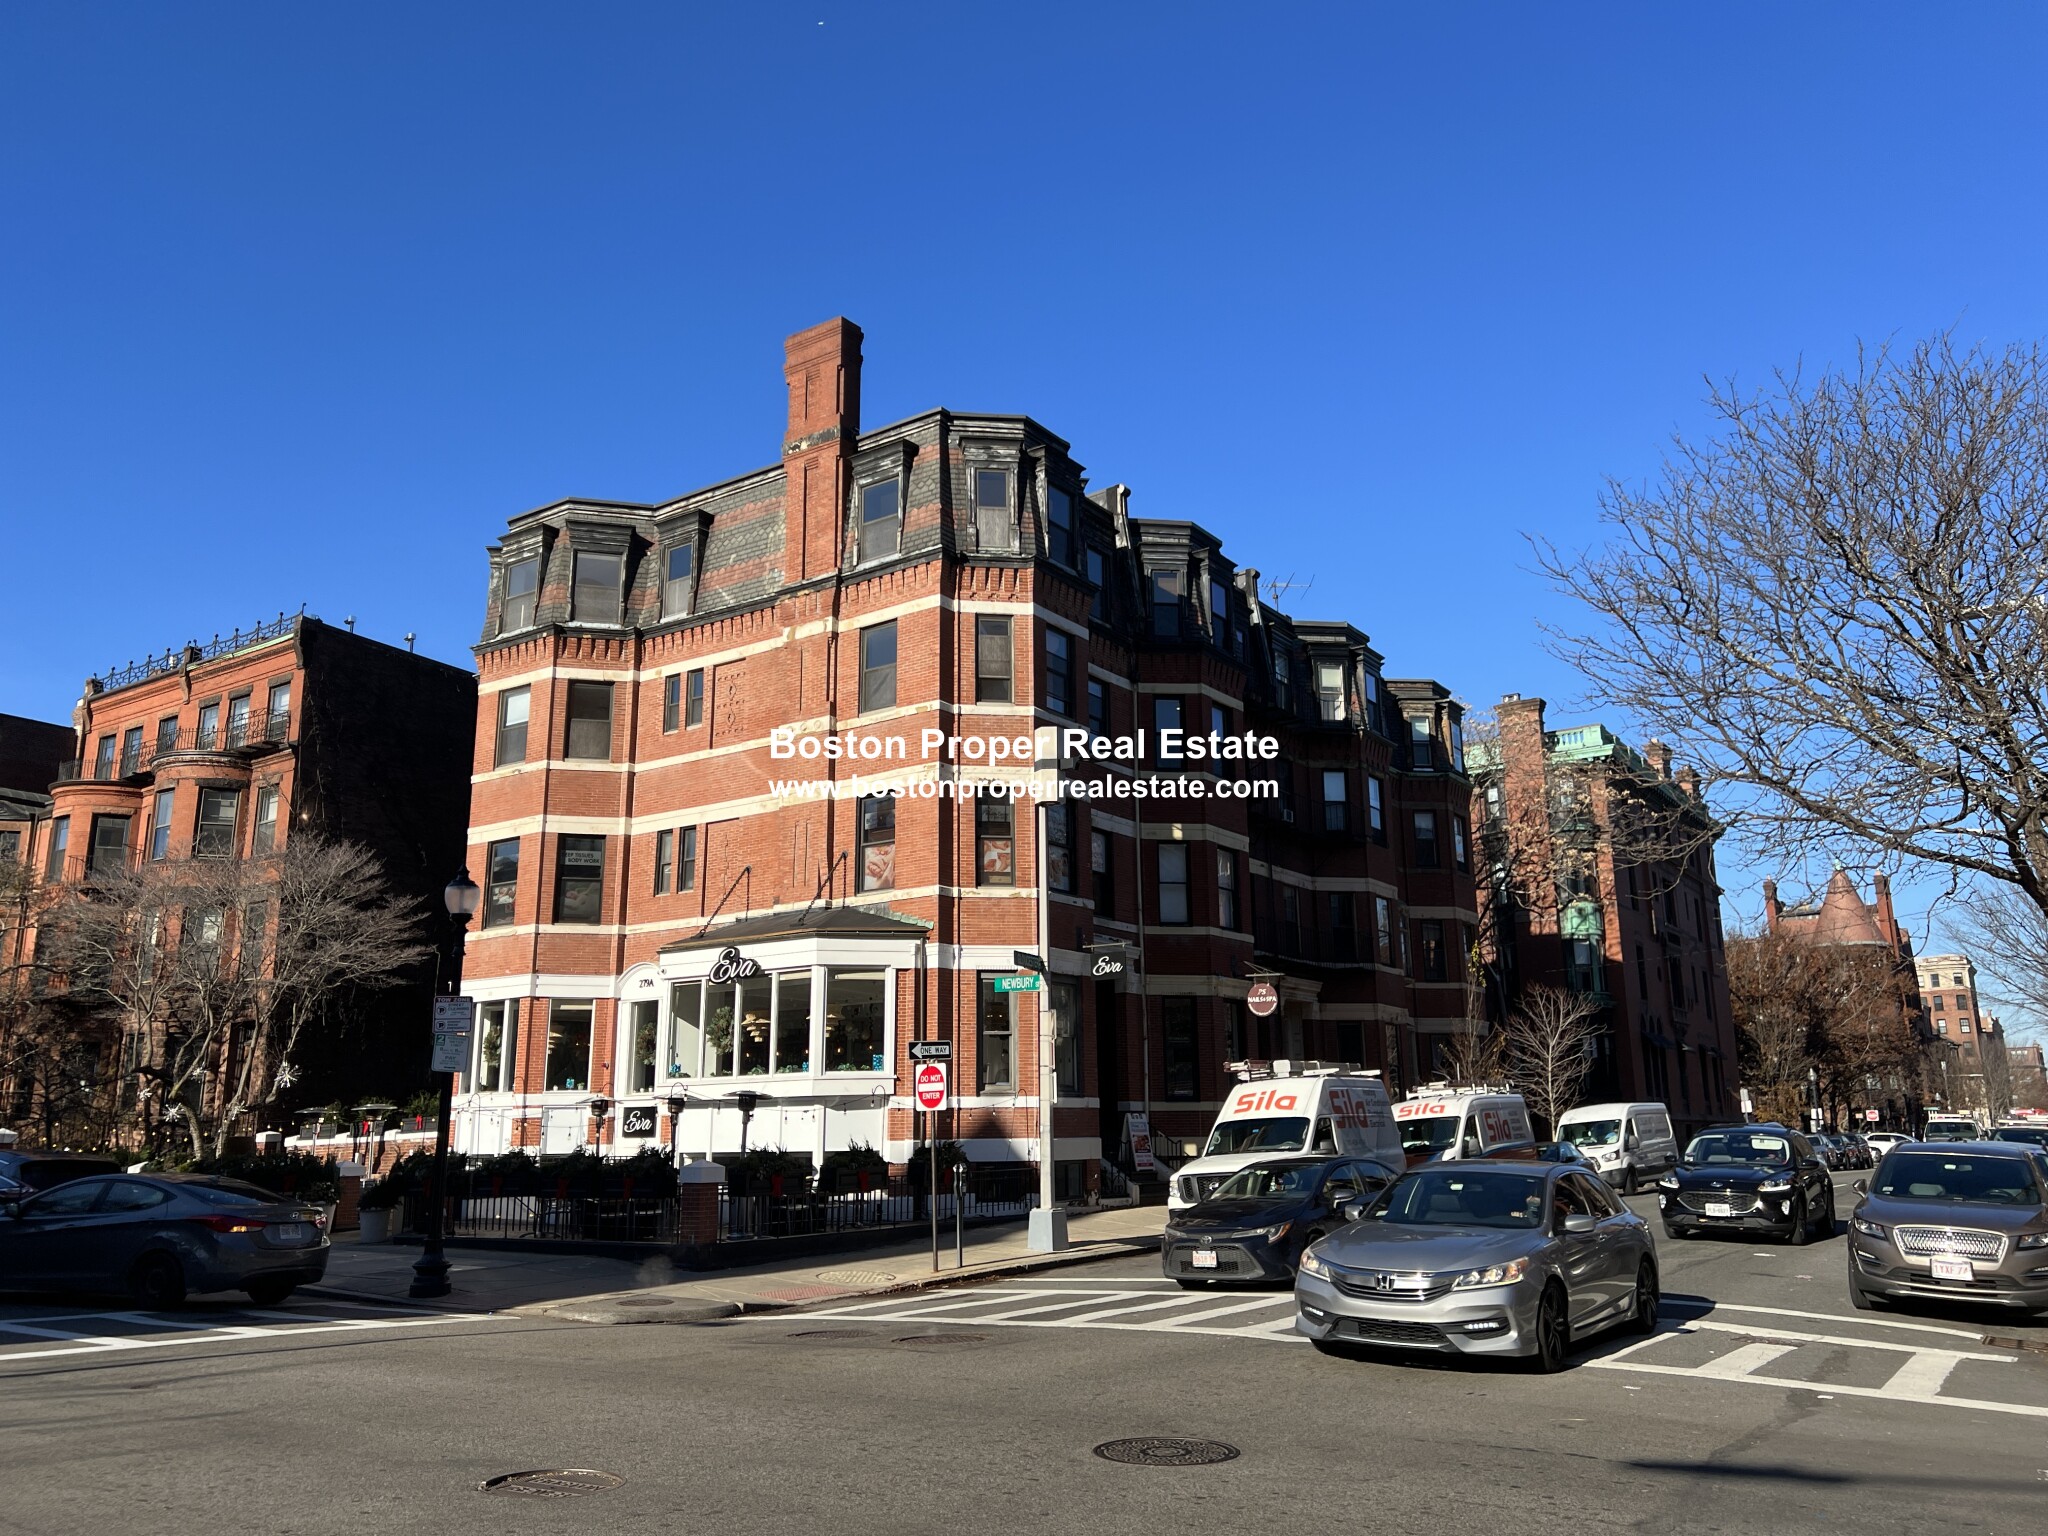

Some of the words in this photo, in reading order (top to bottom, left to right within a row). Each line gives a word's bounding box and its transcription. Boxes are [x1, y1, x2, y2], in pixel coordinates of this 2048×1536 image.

[709, 946, 758, 983] Eva
[1092, 955, 1123, 976] Eva
[638, 978, 655, 988] 279A
[1001, 976, 1034, 990] NEWBURY
[920, 1046, 932, 1055] ONE
[934, 1046, 948, 1054] WAY
[920, 1075, 929, 1083] DO
[930, 1074, 942, 1082] NOT
[922, 1091, 941, 1100] ENTER
[1233, 1089, 1298, 1114] Sila
[1329, 1088, 1369, 1129] Sila
[1397, 1103, 1446, 1118] Sila
[623, 1110, 653, 1133] Eva
[1483, 1110, 1512, 1143] Sila
